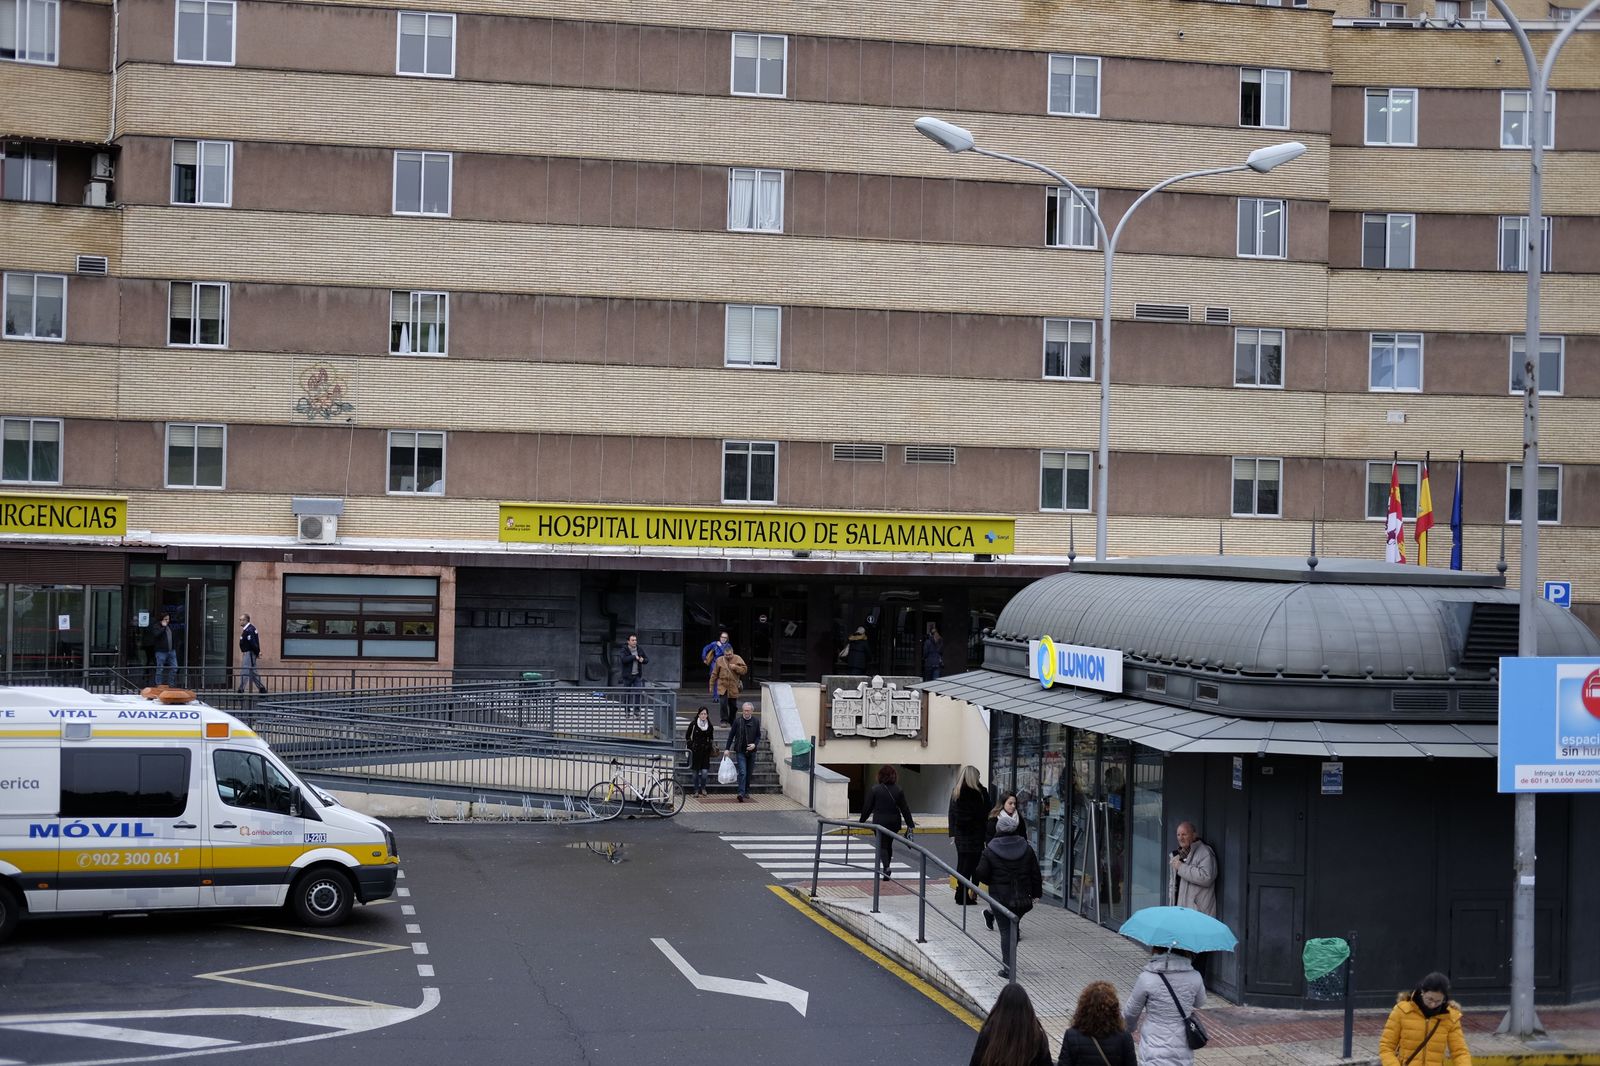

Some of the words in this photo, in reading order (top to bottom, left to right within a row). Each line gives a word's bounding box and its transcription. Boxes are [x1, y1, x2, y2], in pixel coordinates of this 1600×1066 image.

[538, 514, 640, 539] HOSPITAL
[646, 517, 806, 544] UNIVERSITARIO
[813, 522, 839, 544] DE
[846, 523, 975, 547] SALAMANCA
[1549, 584, 1566, 604] P
[1058, 650, 1105, 683] ILUNION
[48, 709, 97, 718] VITAL
[117, 710, 200, 720] AVANZADO
[1562, 745, 1579, 757] sin
[1520, 776, 1529, 784] de
[1565, 769, 1576, 777] Ley
[29, 819, 155, 838] MÓVIL
[92, 852, 119, 866] 902
[124, 852, 150, 865] 300
[154, 851, 180, 865] 061
